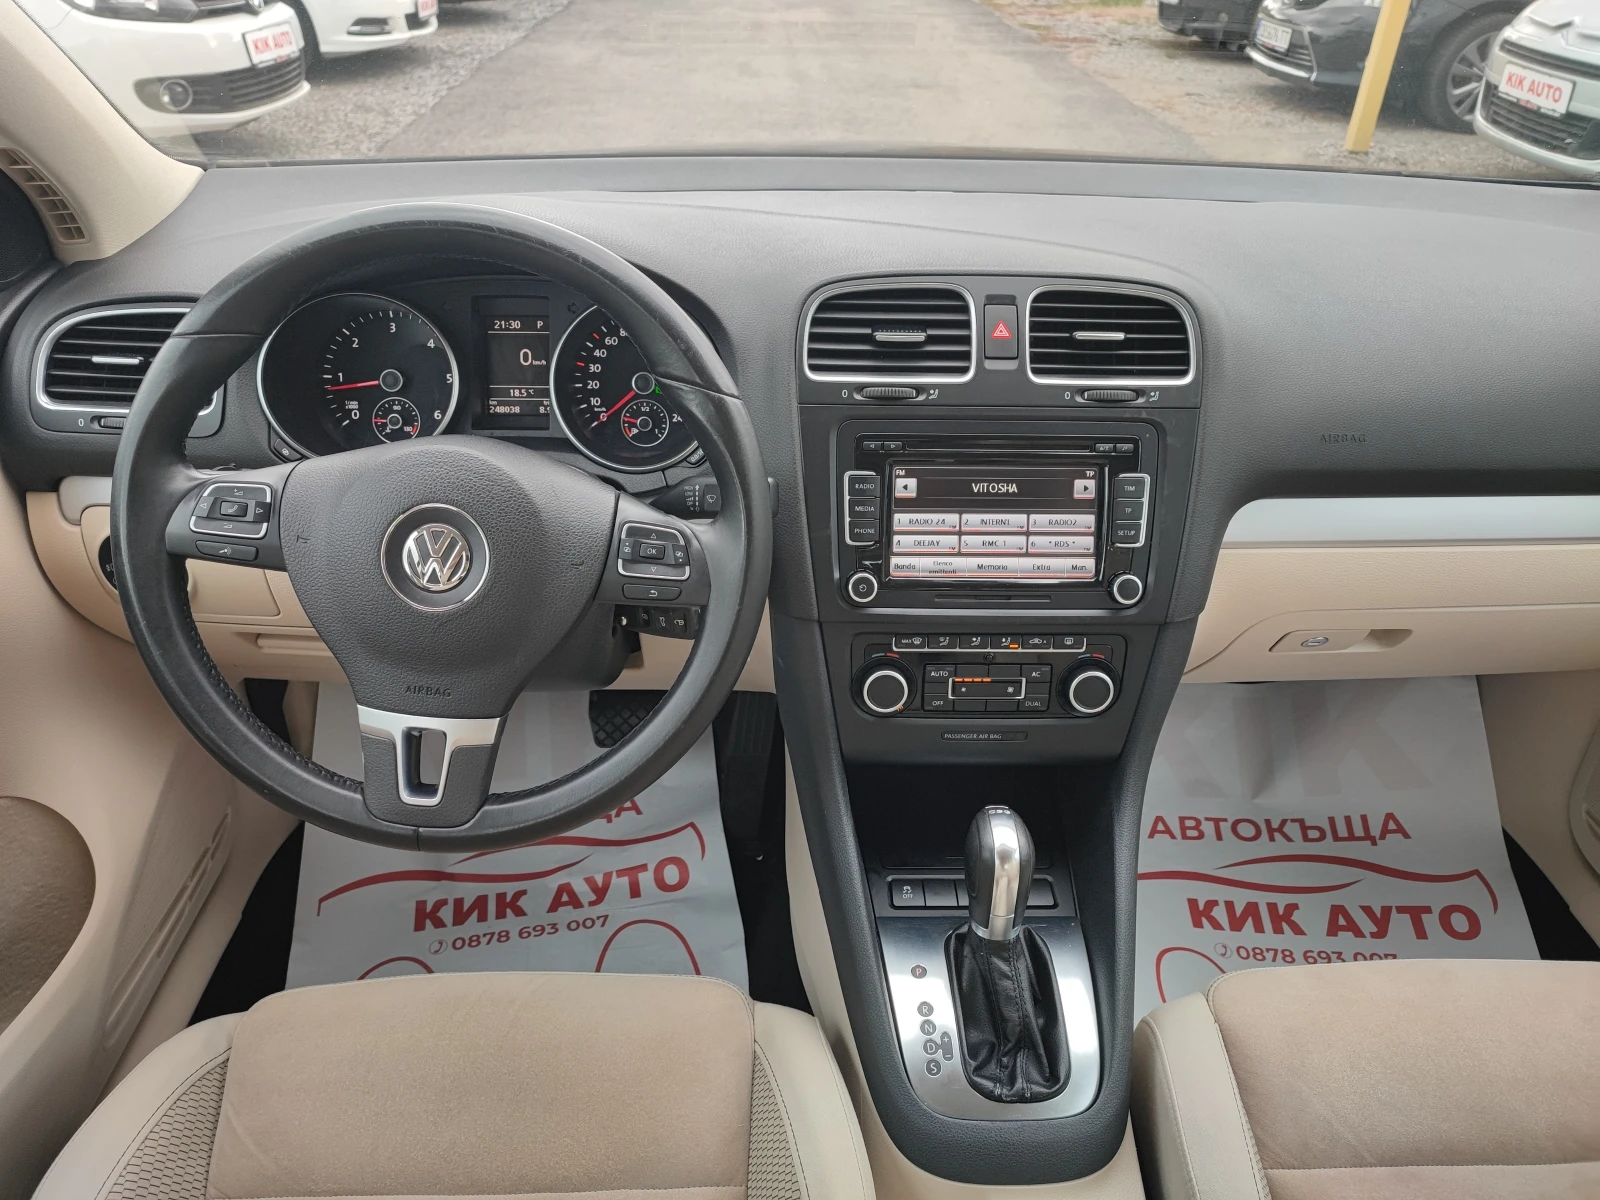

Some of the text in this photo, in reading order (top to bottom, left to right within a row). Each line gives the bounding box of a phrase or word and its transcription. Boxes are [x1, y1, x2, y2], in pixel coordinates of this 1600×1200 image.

[1506, 72, 1562, 104] KIK AUTO
[390, 322, 396, 332] 3
[494, 320, 544, 329] 21:30 P
[352, 338, 359, 348] 2
[427, 339, 435, 348] 4
[605, 336, 618, 346] 60
[520, 348, 532, 366] 0
[594, 349, 607, 358] 40
[588, 364, 601, 372] 30
[338, 372, 342, 382] 1
[446, 374, 452, 384] 5
[586, 380, 600, 389] 20
[590, 398, 600, 406] 10
[352, 410, 360, 419] 0
[434, 410, 442, 420] 6
[1320, 434, 1366, 443] AIRBAG
[972, 482, 1018, 493] VITOSHA
[404, 686, 452, 698] AIRBAG
[1147, 812, 1412, 847] АВТОКЪЩА
[414, 856, 690, 932] КИК АУТО
[1186, 898, 1482, 941] КИК АУТО
[452, 914, 610, 950] 0878 693 007
[1236, 945, 1296, 964] 0878
[1302, 950, 1346, 964] 693
[915, 968, 922, 976] P
[922, 1006, 929, 1014] R
[925, 1024, 932, 1032] N
[928, 1043, 936, 1052] D
[930, 1063, 937, 1073] S
